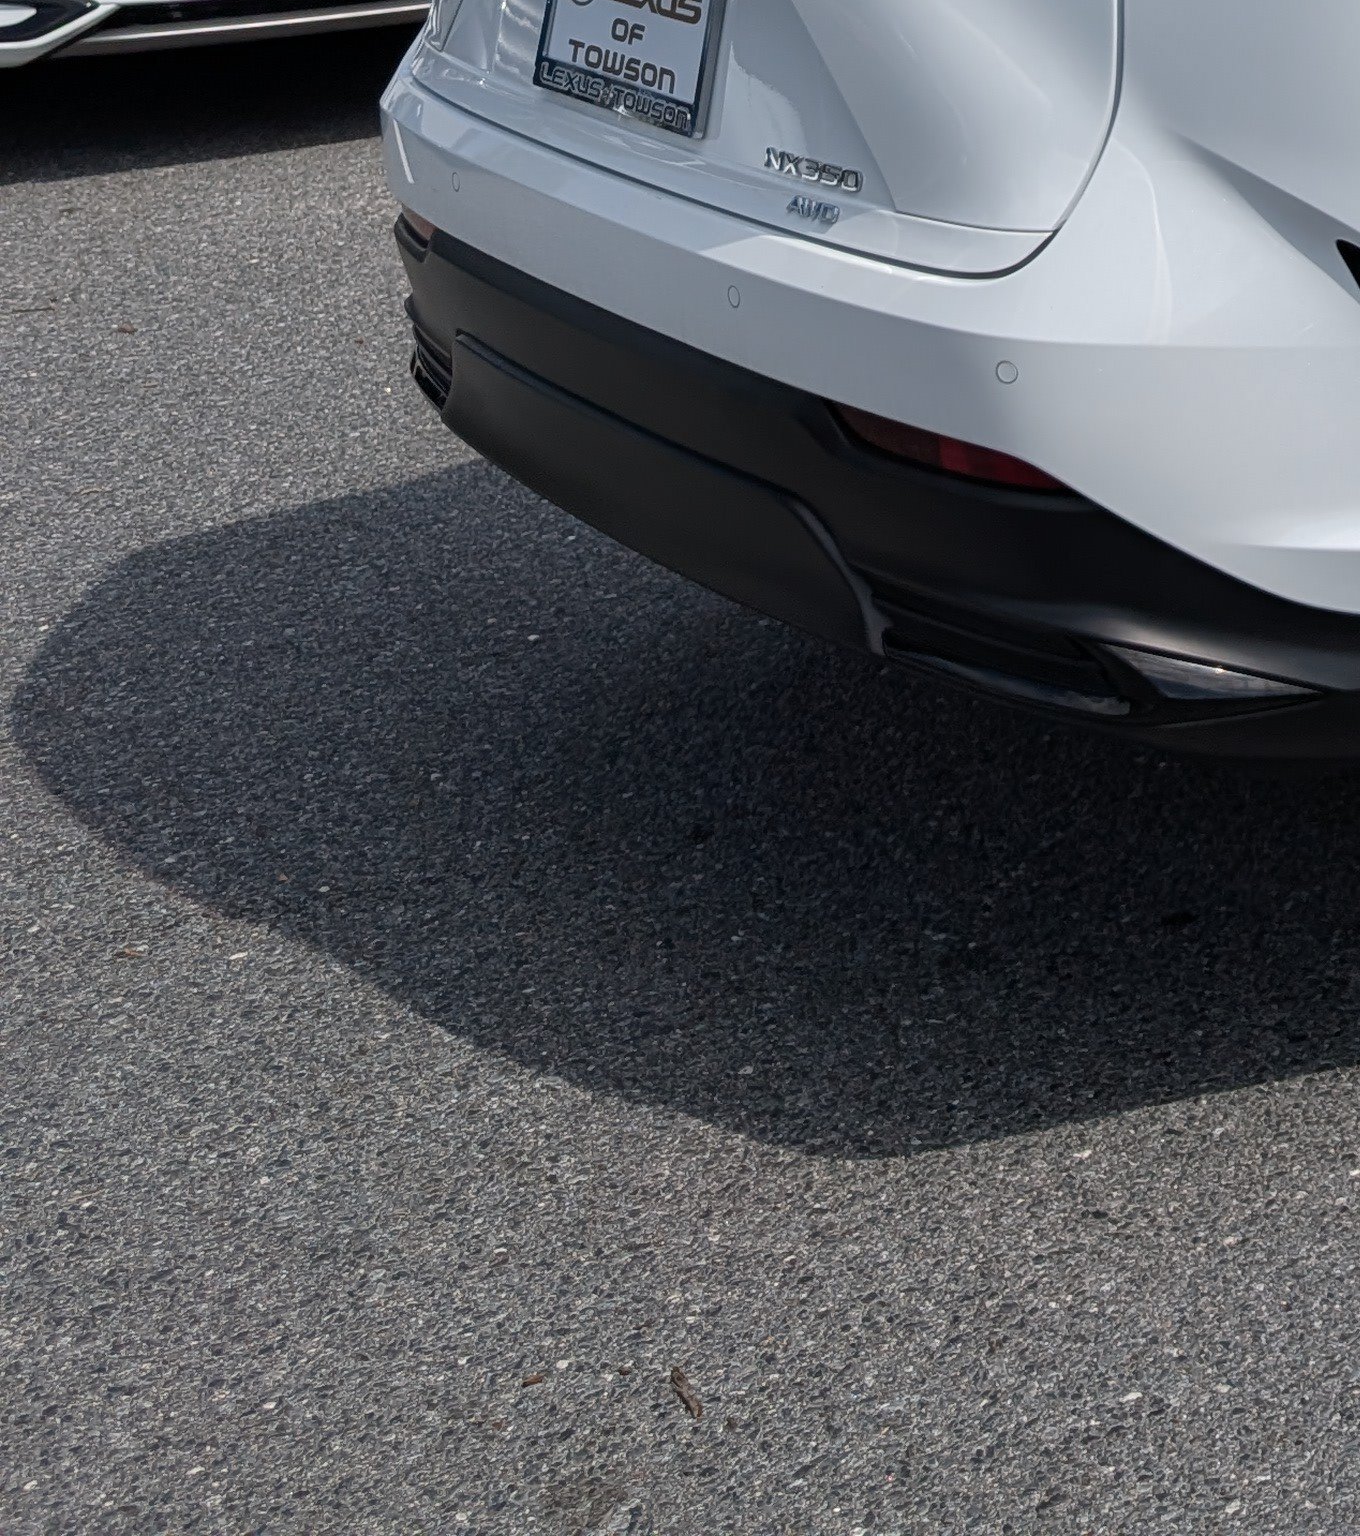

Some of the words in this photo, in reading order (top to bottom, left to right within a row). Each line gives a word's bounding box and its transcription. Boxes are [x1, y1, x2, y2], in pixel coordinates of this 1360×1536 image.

[610, 17, 646, 45] OF
[568, 38, 676, 95] TOWSON
[539, 61, 605, 101] LEXUS
[613, 87, 691, 130] TOWSON
[786, 194, 841, 225] AWD
